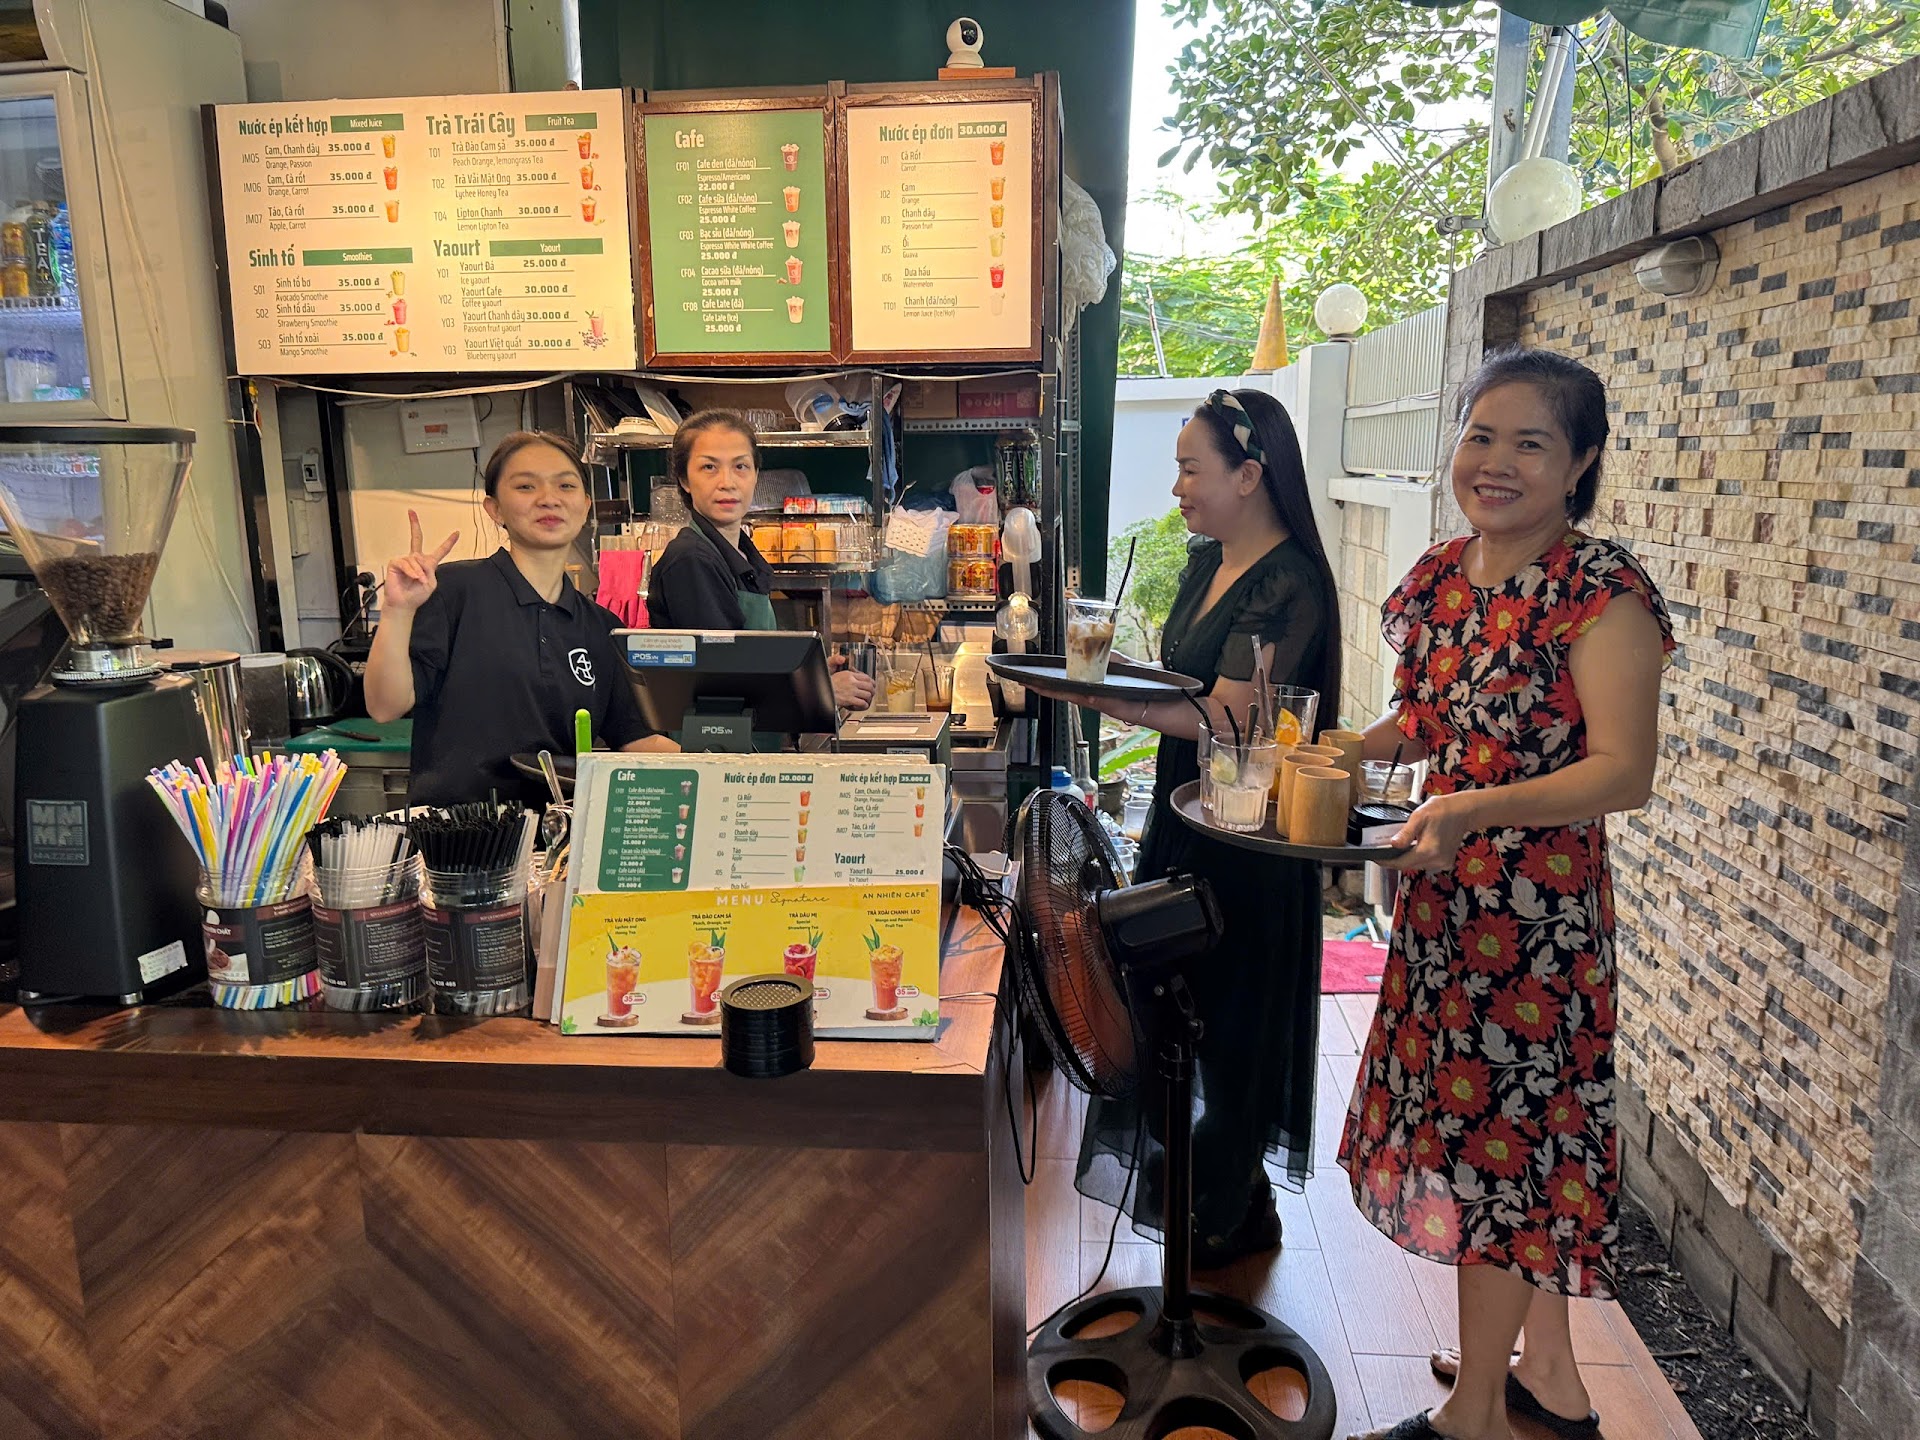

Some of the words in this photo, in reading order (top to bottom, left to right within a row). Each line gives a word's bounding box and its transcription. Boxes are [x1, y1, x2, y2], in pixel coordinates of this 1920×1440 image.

[239, 119, 266, 135] Nước
[270, 118, 282, 137] ép
[285, 114, 303, 133] kết
[307, 117, 327, 136] hợp
[350, 120, 367, 128] Mixed
[368, 119, 382, 127] Juice
[426, 114, 450, 135] Trà
[455, 113, 484, 133] Trái
[489, 112, 515, 137] Cây
[548, 117, 561, 126] Fruit
[563, 116, 574, 125] Tea
[880, 124, 909, 141] Nước
[913, 124, 926, 144] ép
[931, 123, 953, 140] đơn
[960, 125, 996, 135] 30.000
[999, 124, 1005, 133] đ
[675, 129, 704, 148] Cafe
[265, 146, 282, 156] Cam,
[284, 144, 305, 154] Chanh
[328, 143, 362, 151] 35.000
[452, 142, 463, 151] Trà
[466, 142, 479, 151] Đào
[481, 141, 496, 150] Cam
[515, 140, 547, 148] 35.000
[266, 160, 288, 169] Orange,
[676, 162, 689, 171] CF01
[697, 159, 710, 168] Cafe
[712, 159, 723, 168] đen
[455, 175, 466, 184] Trà
[481, 174, 494, 186] Mật
[497, 174, 510, 185] Ong
[517, 173, 548, 181] 35.000
[699, 183, 727, 191] 22.000
[902, 183, 915, 191] Cam
[456, 190, 476, 200] Lychee
[478, 189, 496, 199] Honey
[678, 195, 692, 204] CF02
[699, 194, 712, 203] Cafe
[713, 193, 724, 203] sữa
[457, 208, 479, 219] Lipton
[481, 207, 502, 217] Chanh
[519, 206, 550, 214] 30.000
[902, 209, 921, 217] Chanh
[680, 230, 693, 240] CF03
[433, 240, 480, 256] Yaourt
[540, 243, 560, 252] Yaourt
[249, 249, 278, 266] Sinh
[282, 244, 295, 266] tố
[343, 252, 372, 261] Smoothies
[460, 262, 483, 271] Yaourt
[486, 261, 494, 270] Đá
[524, 259, 558, 268] 25.000
[702, 266, 719, 275] Cacao
[720, 266, 731, 275] sữa
[681, 268, 695, 278] CF04
[276, 278, 291, 288] Sinh
[293, 276, 300, 287] tố
[302, 278, 310, 287] bơ
[683, 302, 698, 312] CF08
[702, 299, 716, 308] Cafe
[717, 299, 730, 308] Late
[731, 298, 744, 309] (đá)
[465, 339, 488, 348] Yaourt
[490, 338, 504, 349] Việt
[506, 336, 521, 350] quất
[280, 348, 300, 357] Mango
[618, 771, 635, 781] Cafe
[724, 772, 745, 783] Nước
[747, 773, 757, 786] ép
[760, 773, 775, 783] đơn
[840, 773, 857, 783] Nước
[860, 774, 868, 784] ép
[870, 771, 882, 782] kết
[884, 774, 897, 785] hợp
[835, 853, 865, 864] Yaourt
[716, 895, 764, 906] MENU
[770, 891, 830, 906] Signature
